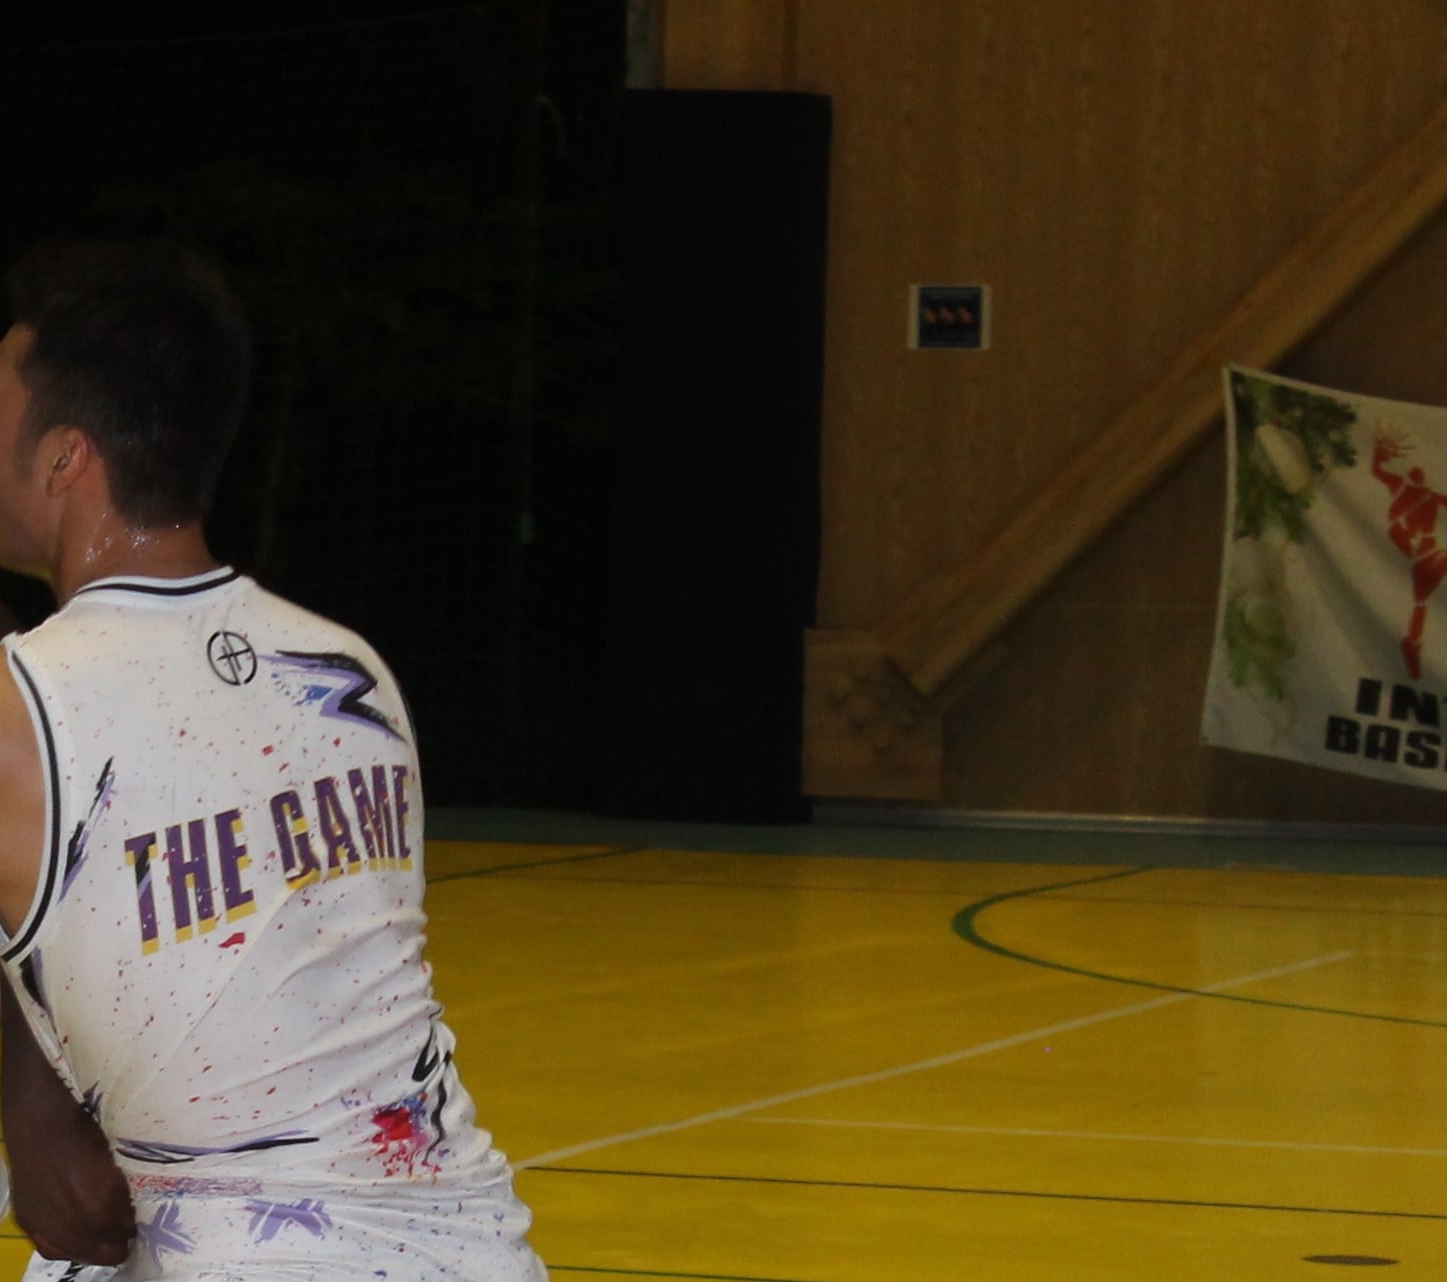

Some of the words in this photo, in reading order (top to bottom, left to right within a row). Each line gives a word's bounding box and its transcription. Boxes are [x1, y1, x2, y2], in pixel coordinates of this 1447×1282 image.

[1356, 677, 1447, 728] IN
[1325, 715, 1447, 772] BAS
[124, 806, 258, 957] THE
[270, 764, 414, 891] GAME
